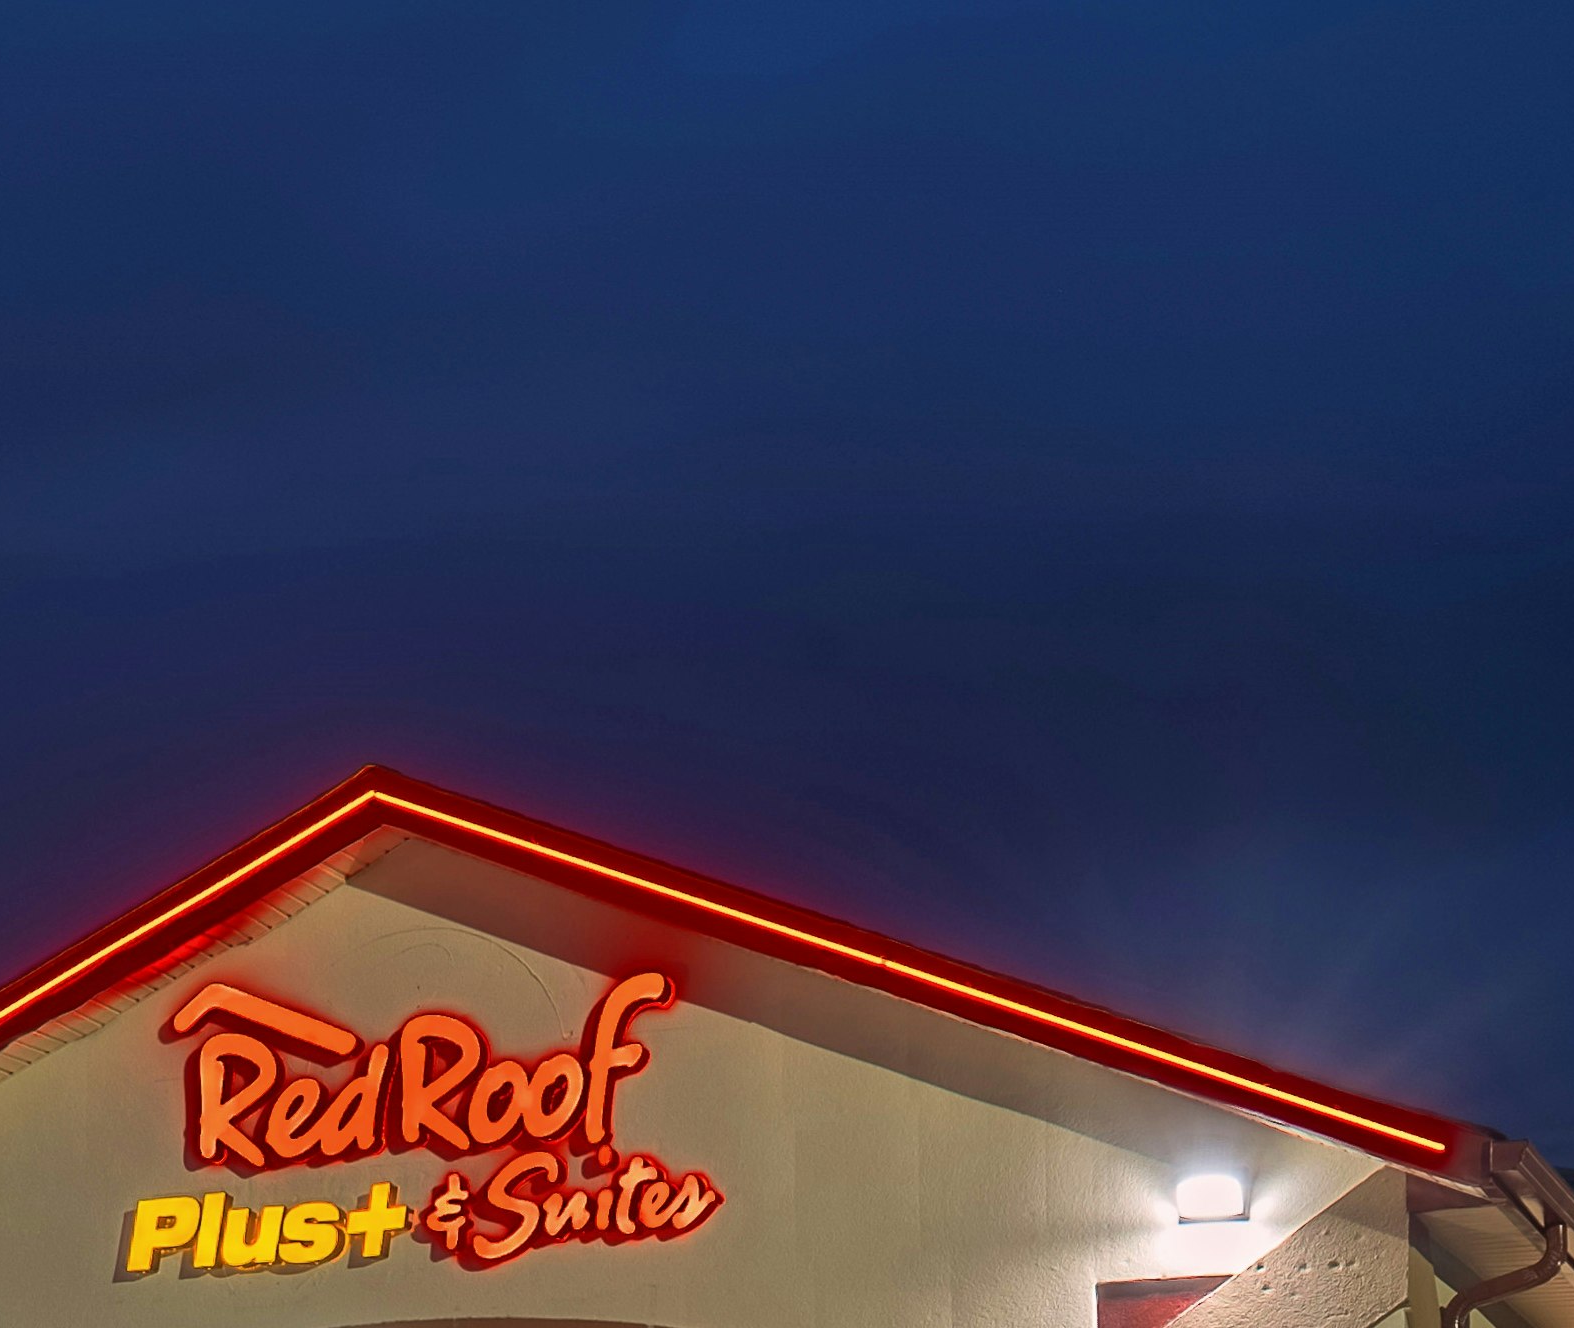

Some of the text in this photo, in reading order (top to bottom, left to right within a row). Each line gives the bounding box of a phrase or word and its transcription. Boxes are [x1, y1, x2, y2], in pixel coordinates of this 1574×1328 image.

[126, 1145, 718, 1272] Plus+ & Suites
